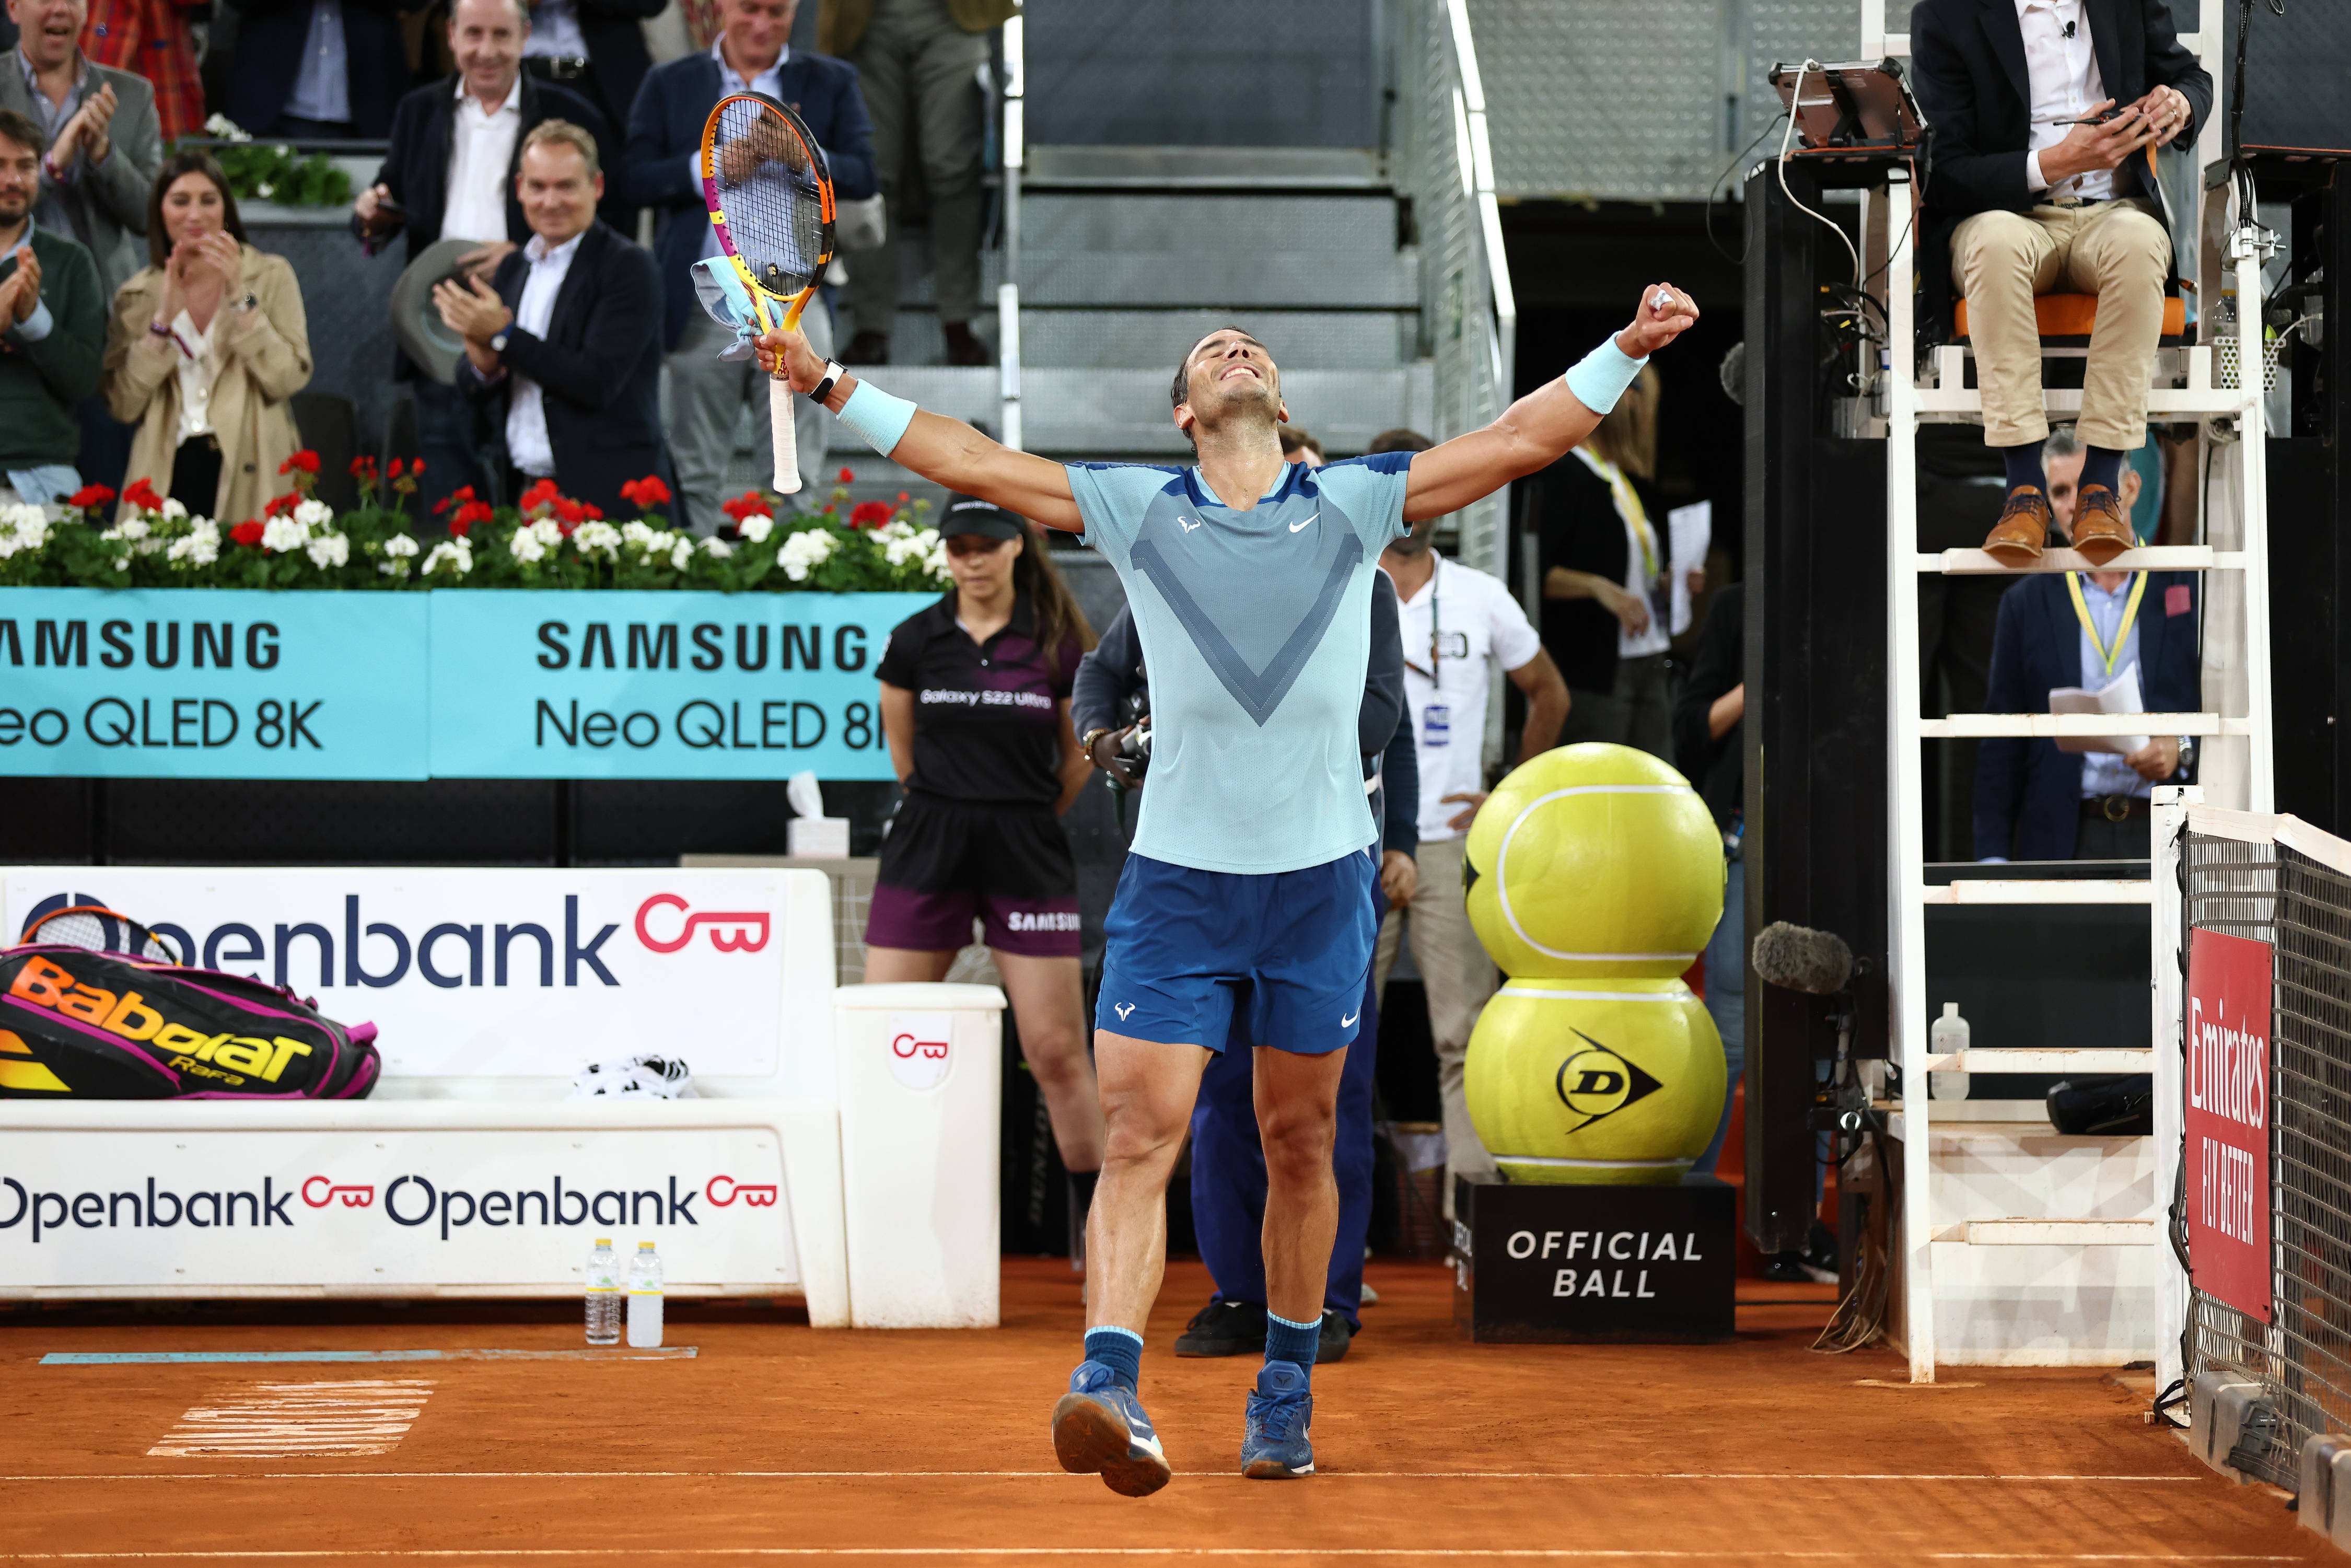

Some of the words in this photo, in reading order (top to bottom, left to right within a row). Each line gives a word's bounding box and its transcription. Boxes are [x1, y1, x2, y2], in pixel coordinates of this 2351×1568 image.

[538, 621, 867, 671] SAMSUNG
[920, 689, 981, 706] Galaxy
[981, 690, 1014, 705] S22
[84, 697, 239, 748] QLED
[255, 699, 324, 749] 8K
[536, 699, 660, 748] Neo
[676, 700, 827, 749] QLED
[2191, 995, 2264, 1131] Emirates
[0, 1177, 294, 1242] Openbank
[385, 1175, 699, 1240] Openbank
[2202, 1135, 2218, 1229] FLY
[2220, 1142, 2254, 1247] BETTER
[1507, 1230, 1703, 1261] OFFICIAL
[1553, 1269, 1656, 1298] BALL
